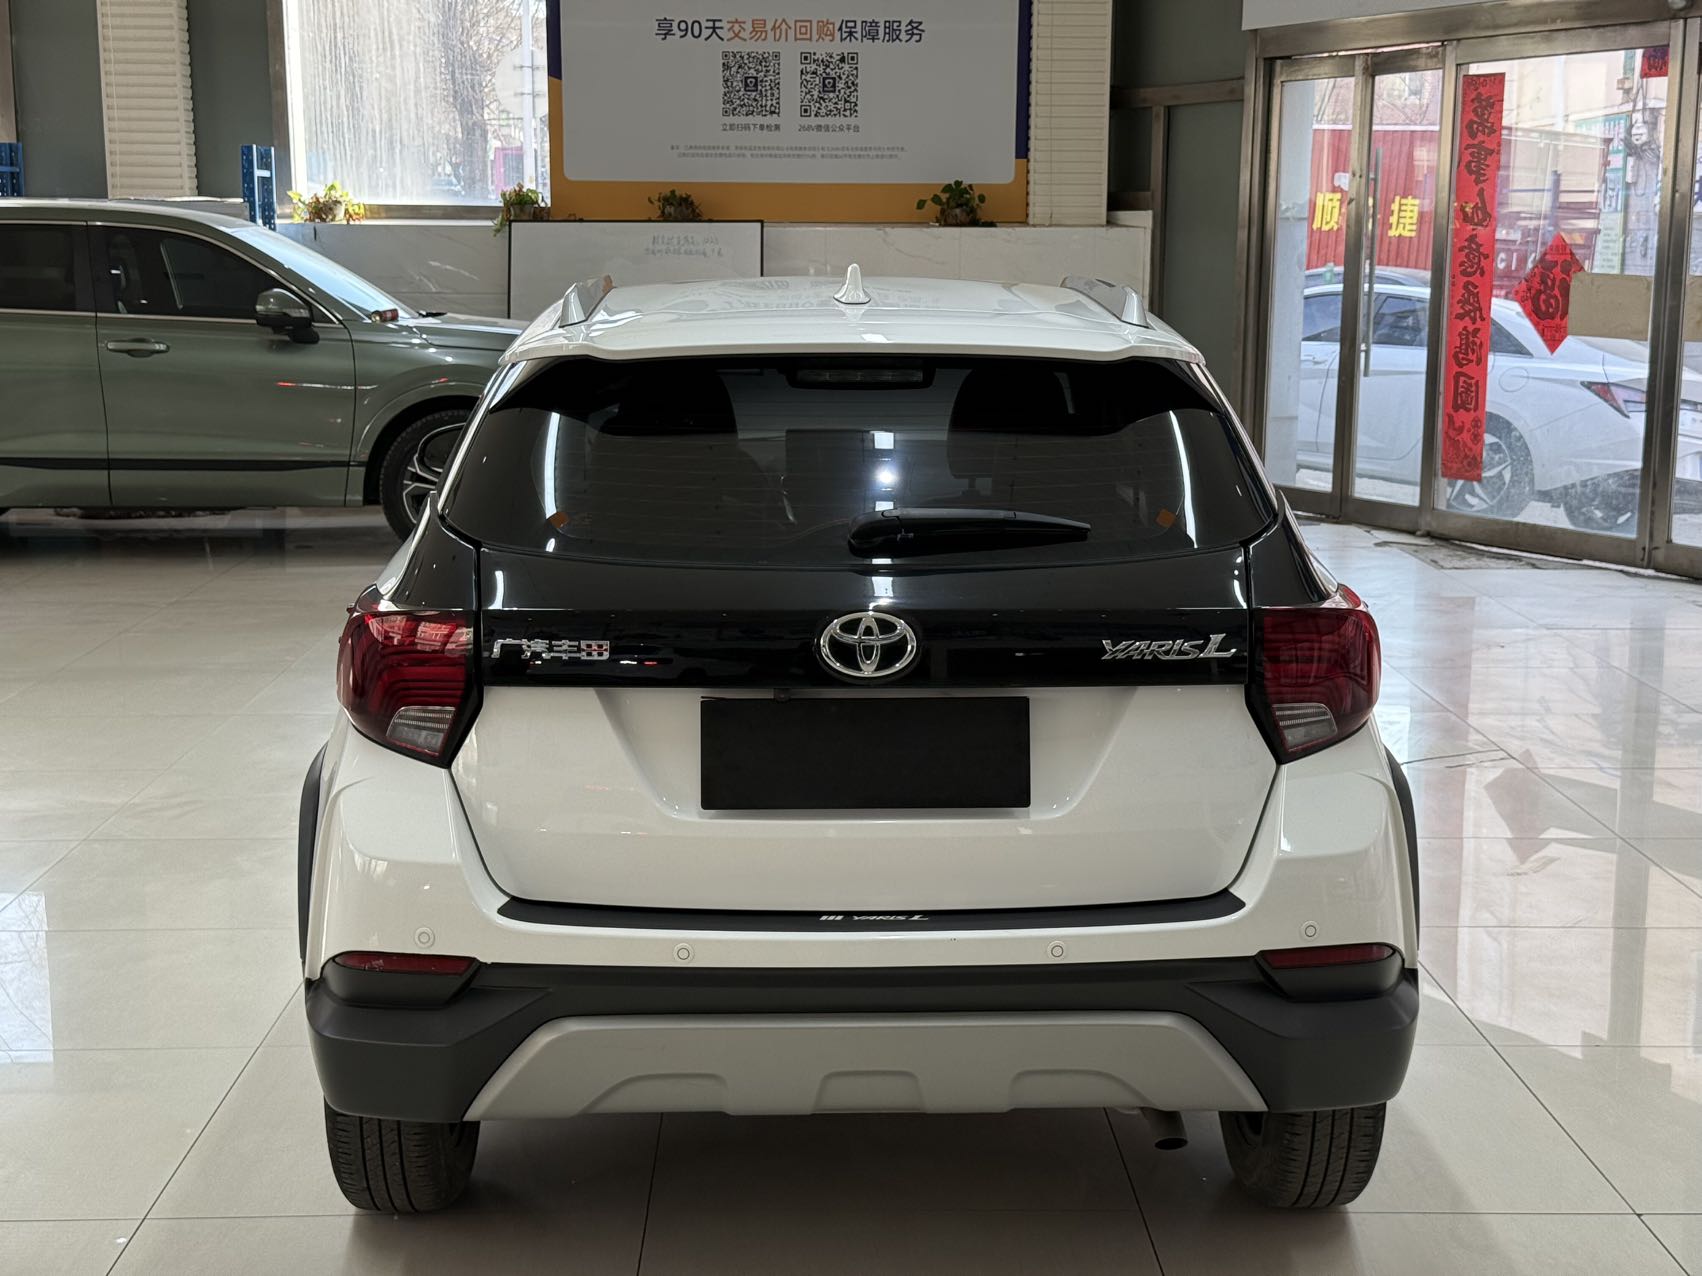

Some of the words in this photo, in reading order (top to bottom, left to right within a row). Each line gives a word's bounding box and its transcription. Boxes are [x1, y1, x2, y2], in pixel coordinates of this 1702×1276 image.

[654, 17, 926, 43] 享90天交易价回购保障服务
[721, 122, 781, 132] 立即扫码下单检测
[491, 638, 609, 660] 广汽丰田
